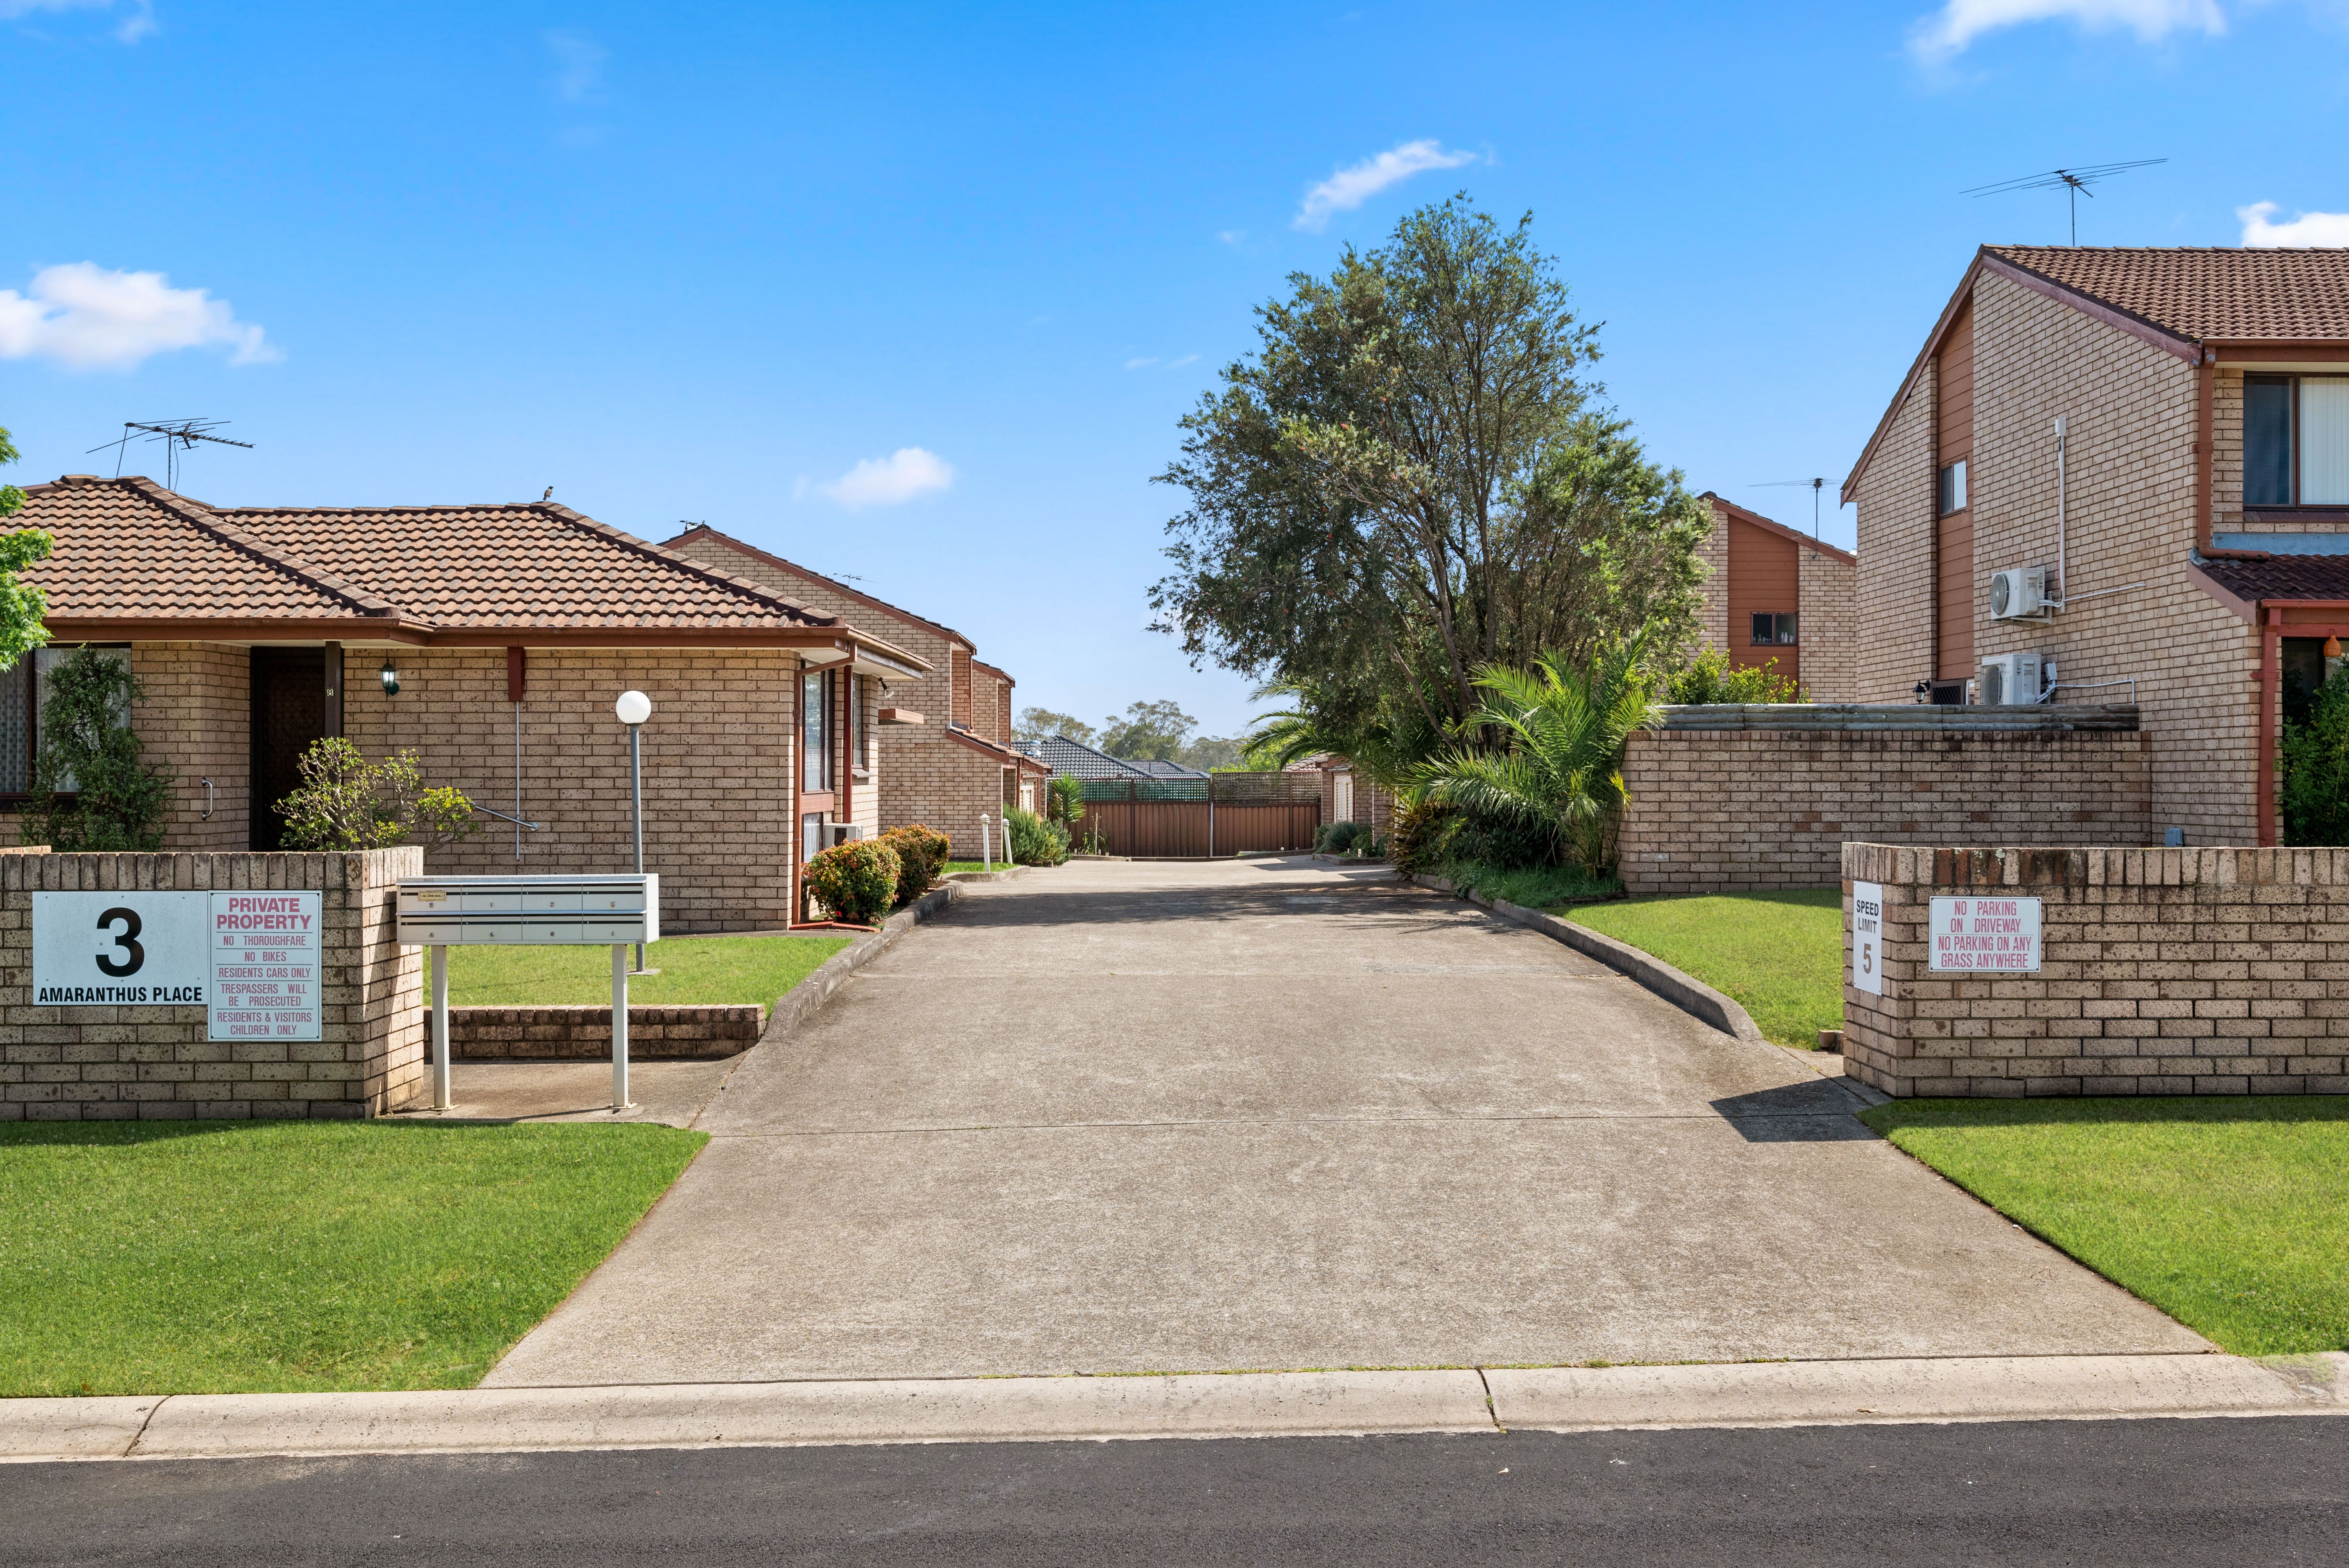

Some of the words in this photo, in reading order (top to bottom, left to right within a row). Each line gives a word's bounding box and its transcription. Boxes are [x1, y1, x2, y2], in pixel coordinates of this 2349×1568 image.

[229, 898, 300, 912] PRIVATE
[1857, 900, 1879, 916] SPEED
[1955, 901, 1966, 915] NO
[1978, 901, 2016, 915] PARKING
[217, 915, 312, 929] PROPERTY
[1859, 917, 1877, 933] LIMIT
[1951, 918, 1963, 933] ON
[1975, 918, 2021, 933] DRIVEWAY
[96, 907, 145, 977] 3
[224, 936, 234, 945] NO
[244, 935, 306, 945] THOROUGHFARE
[1938, 936, 1950, 950] NO
[1954, 936, 1993, 951] PARKING
[1997, 937, 2009, 951] ON
[2013, 937, 2031, 951] ANY
[245, 952, 255, 961] NO
[263, 952, 286, 961] BIKES
[1863, 943, 1871, 974] 5
[1942, 953, 1972, 967] GRASS
[1976, 953, 2028, 968] ANYWHERE
[219, 968, 263, 977] RESIDENTS
[267, 968, 288, 977] CARS
[291, 968, 310, 977] ONLY
[39, 987, 147, 1001] AMARANTHUS
[154, 987, 201, 1001] PLACE
[221, 984, 278, 994] TRESPASSERS
[288, 984, 307, 994] WILL
[229, 996, 238, 1006] BE
[249, 996, 300, 1006] PROSECUTED
[218, 1012, 262, 1022] RESIDENTS
[265, 1012, 271, 1022] &
[275, 1012, 312, 1022] VISITORS
[231, 1025, 269, 1035] CHILDREN
[278, 1025, 296, 1035] ONLY
